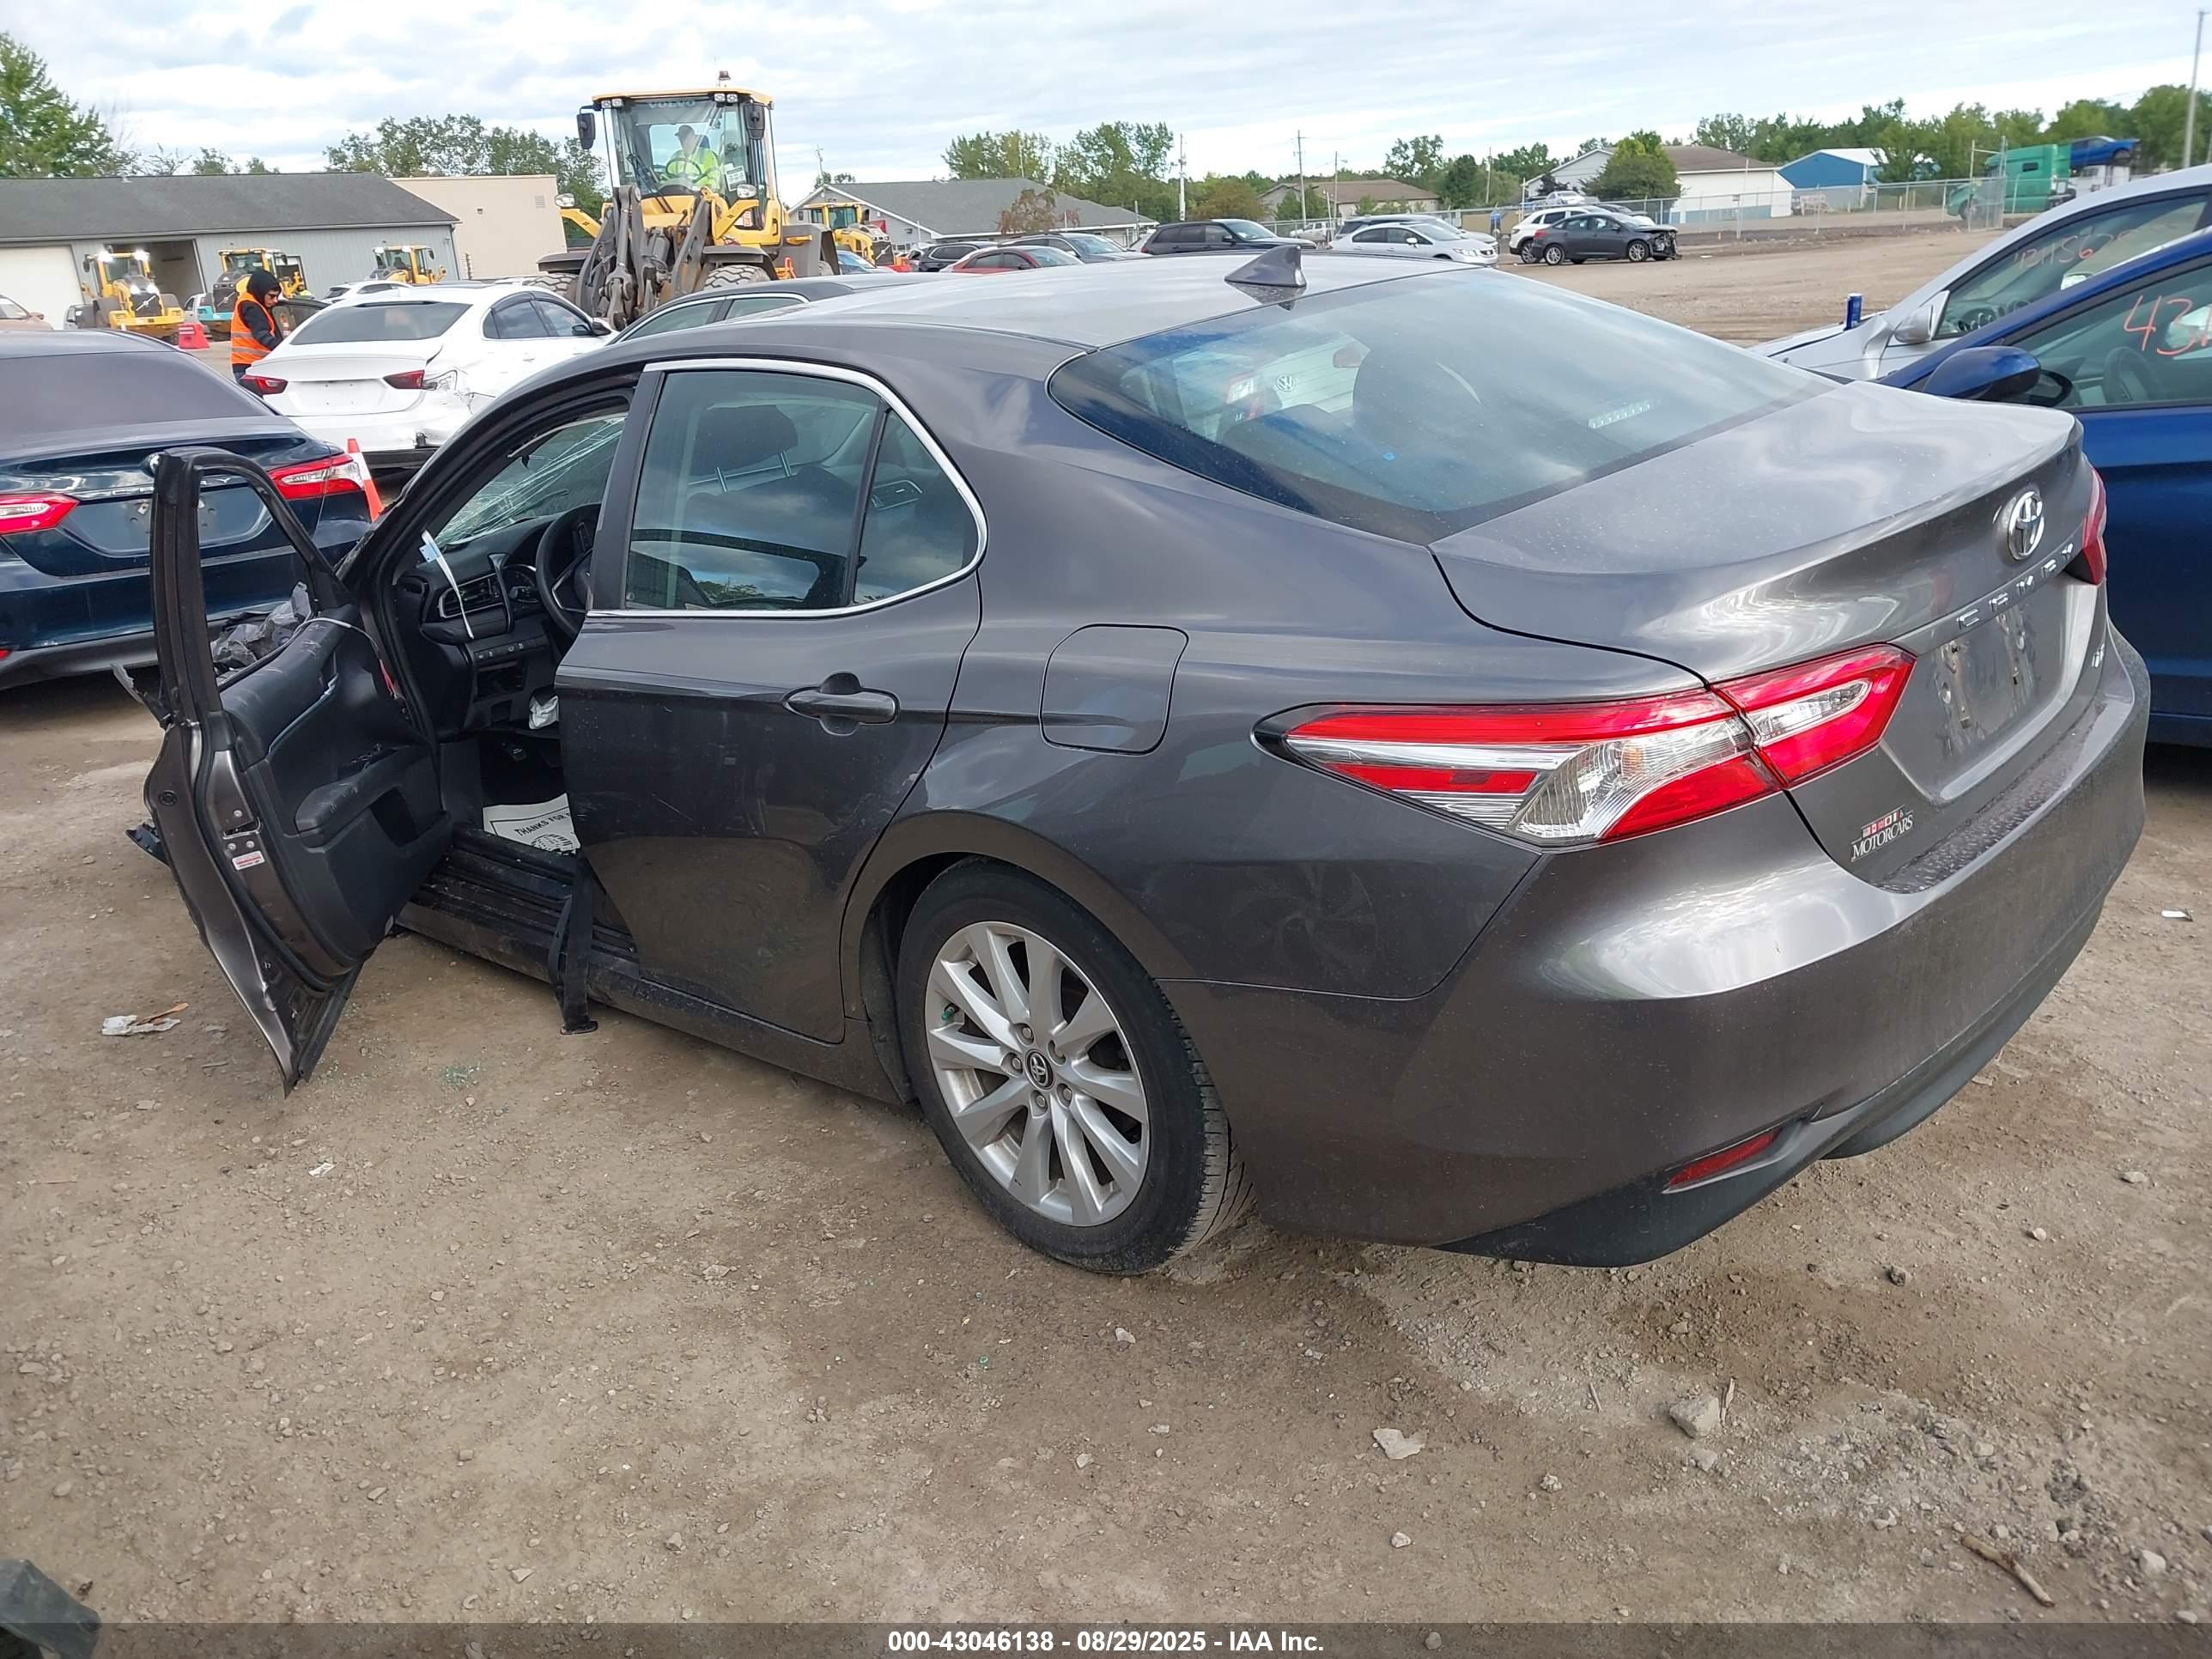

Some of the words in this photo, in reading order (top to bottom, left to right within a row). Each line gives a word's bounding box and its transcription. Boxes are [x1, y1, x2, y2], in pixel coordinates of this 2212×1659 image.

[648, 100, 696, 109] VOLVO
[514, 820, 550, 836] THANKS
[1851, 814, 1914, 860] MOTORCARS
